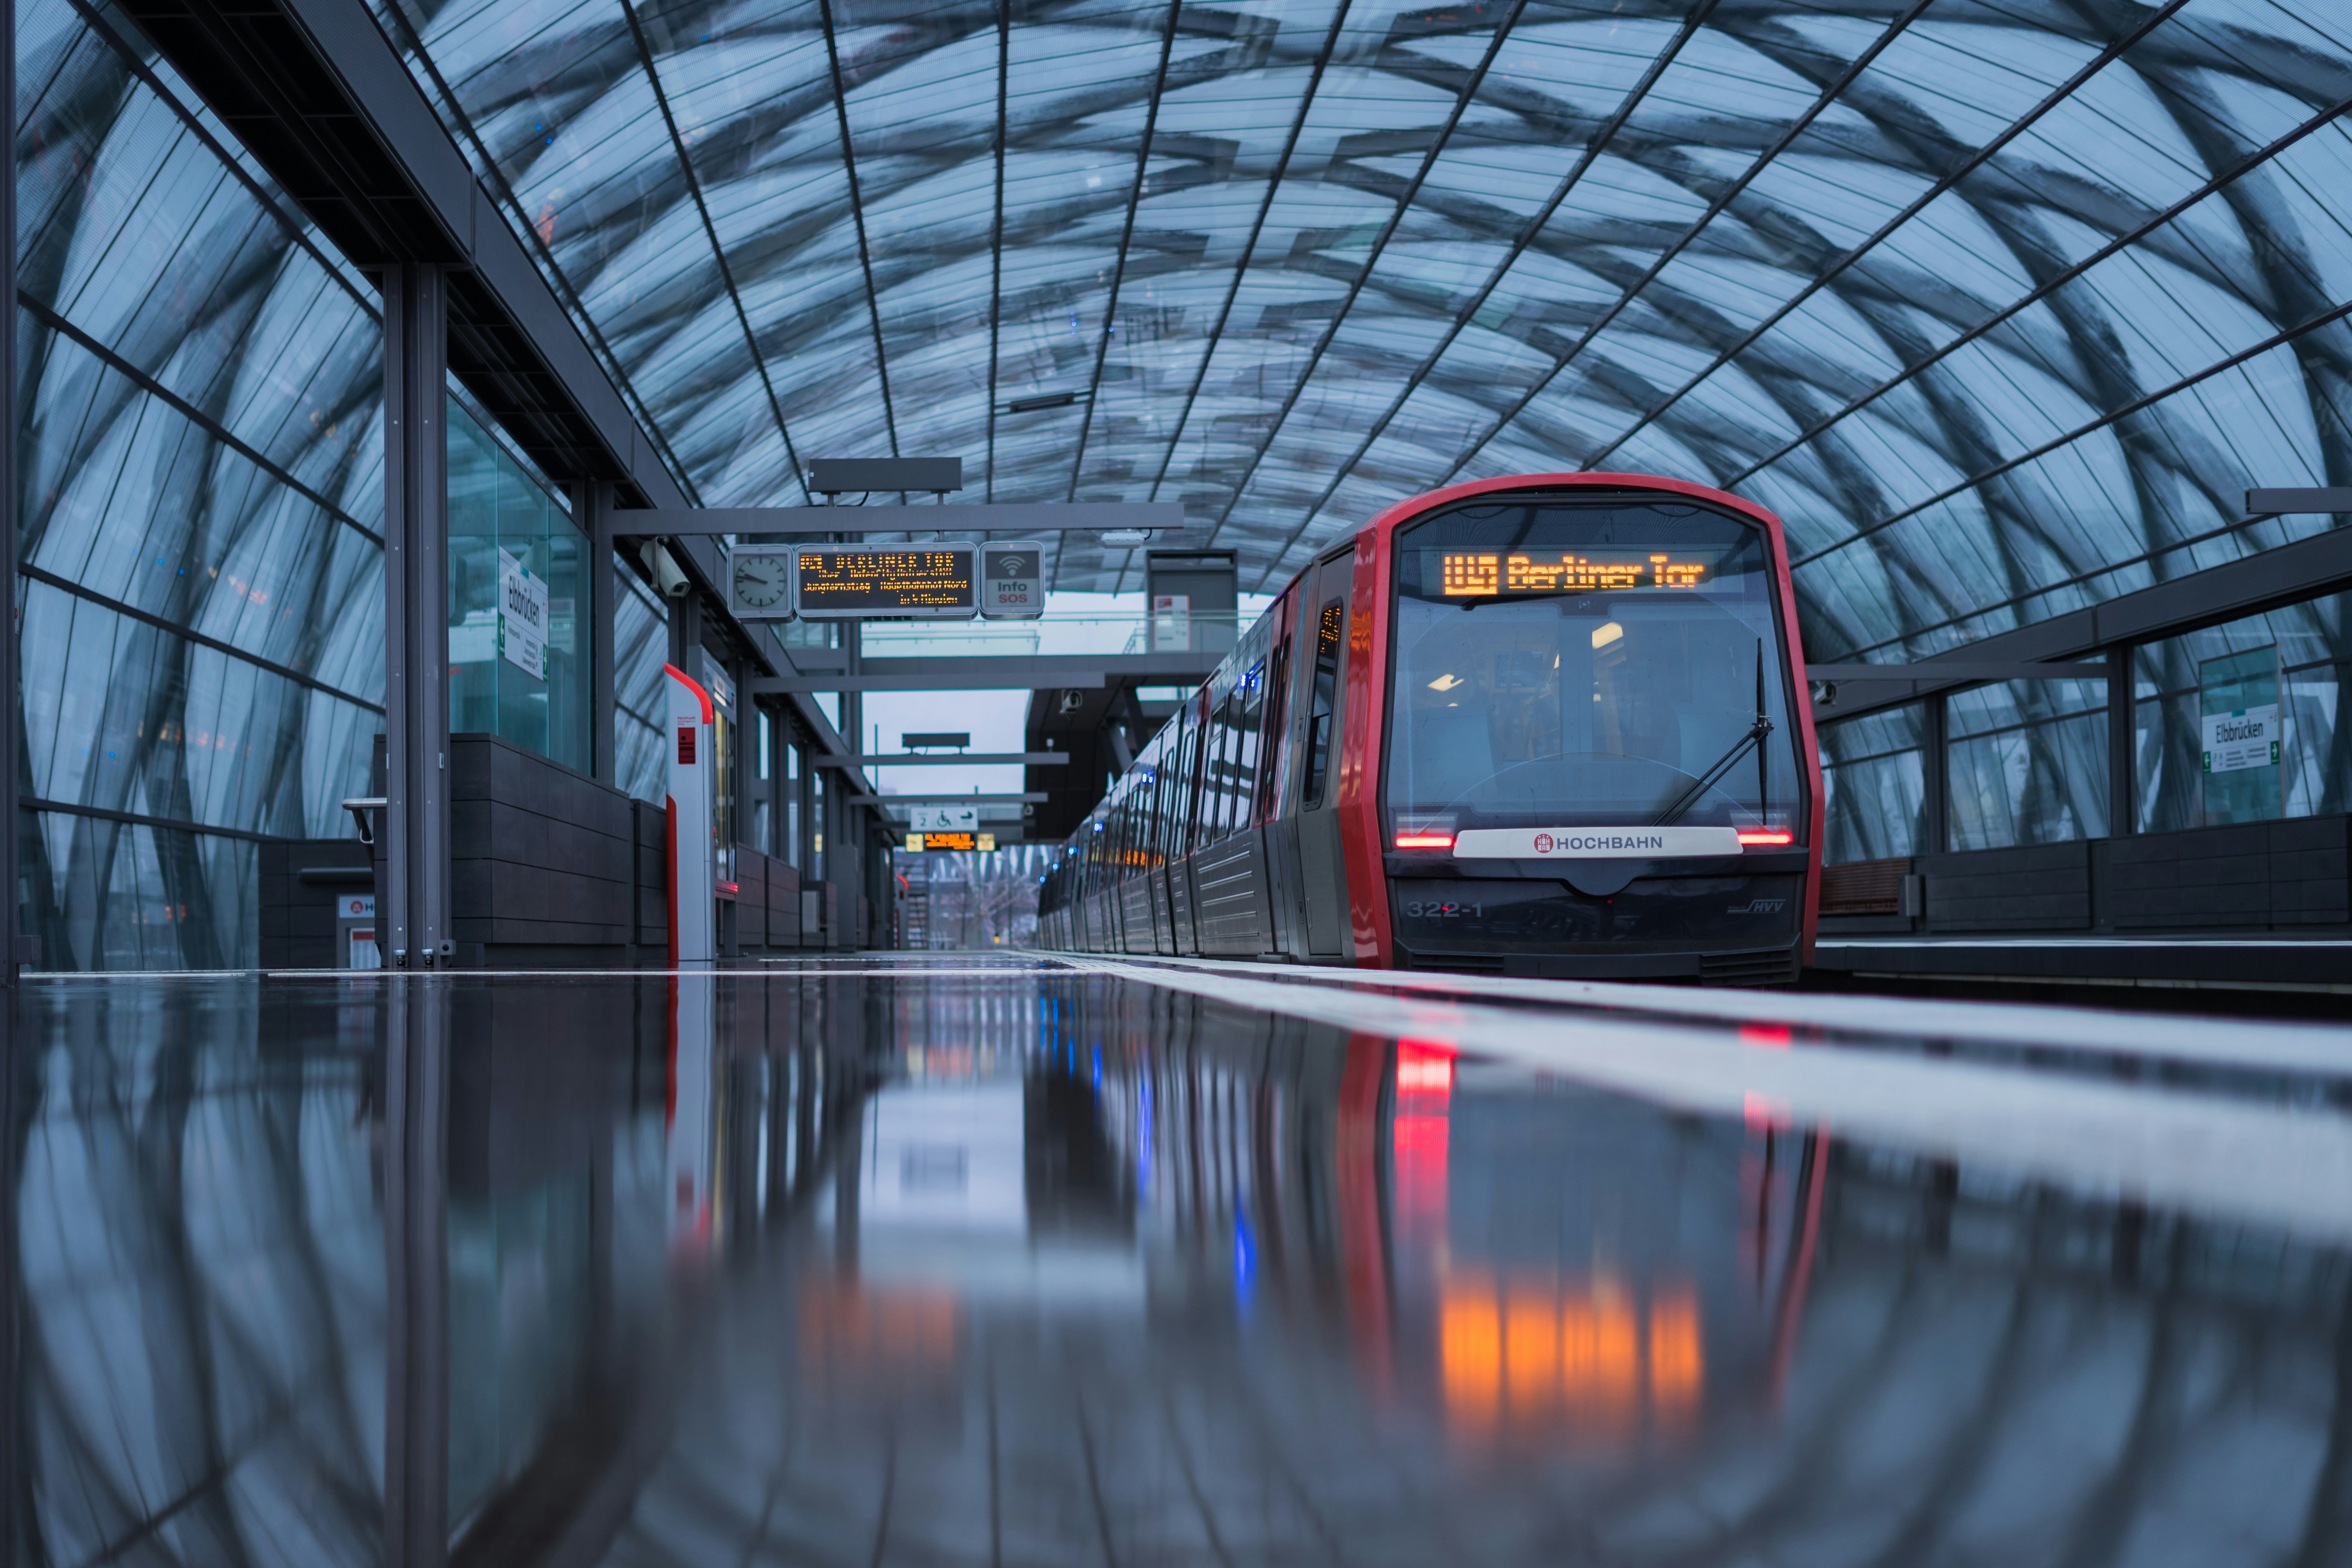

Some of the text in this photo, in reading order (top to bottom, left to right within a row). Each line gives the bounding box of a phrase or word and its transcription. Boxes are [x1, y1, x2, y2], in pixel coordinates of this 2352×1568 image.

[1508, 556, 1642, 589] Berliner
[1650, 555, 1704, 588] Tor
[804, 582, 871, 593] Jungfernstieg
[944, 580, 967, 589] Nord
[998, 581, 1027, 592] Info
[509, 575, 539, 628] Elbbrücken
[920, 593, 958, 604] Minuten
[998, 594, 1027, 604] SOS
[2216, 719, 2263, 743] Elbbrücken
[920, 817, 926, 827] 2
[1556, 837, 1662, 850] HOCHBAHN
[1406, 901, 1481, 918] 322-1
[1753, 902, 1784, 912] HVV
